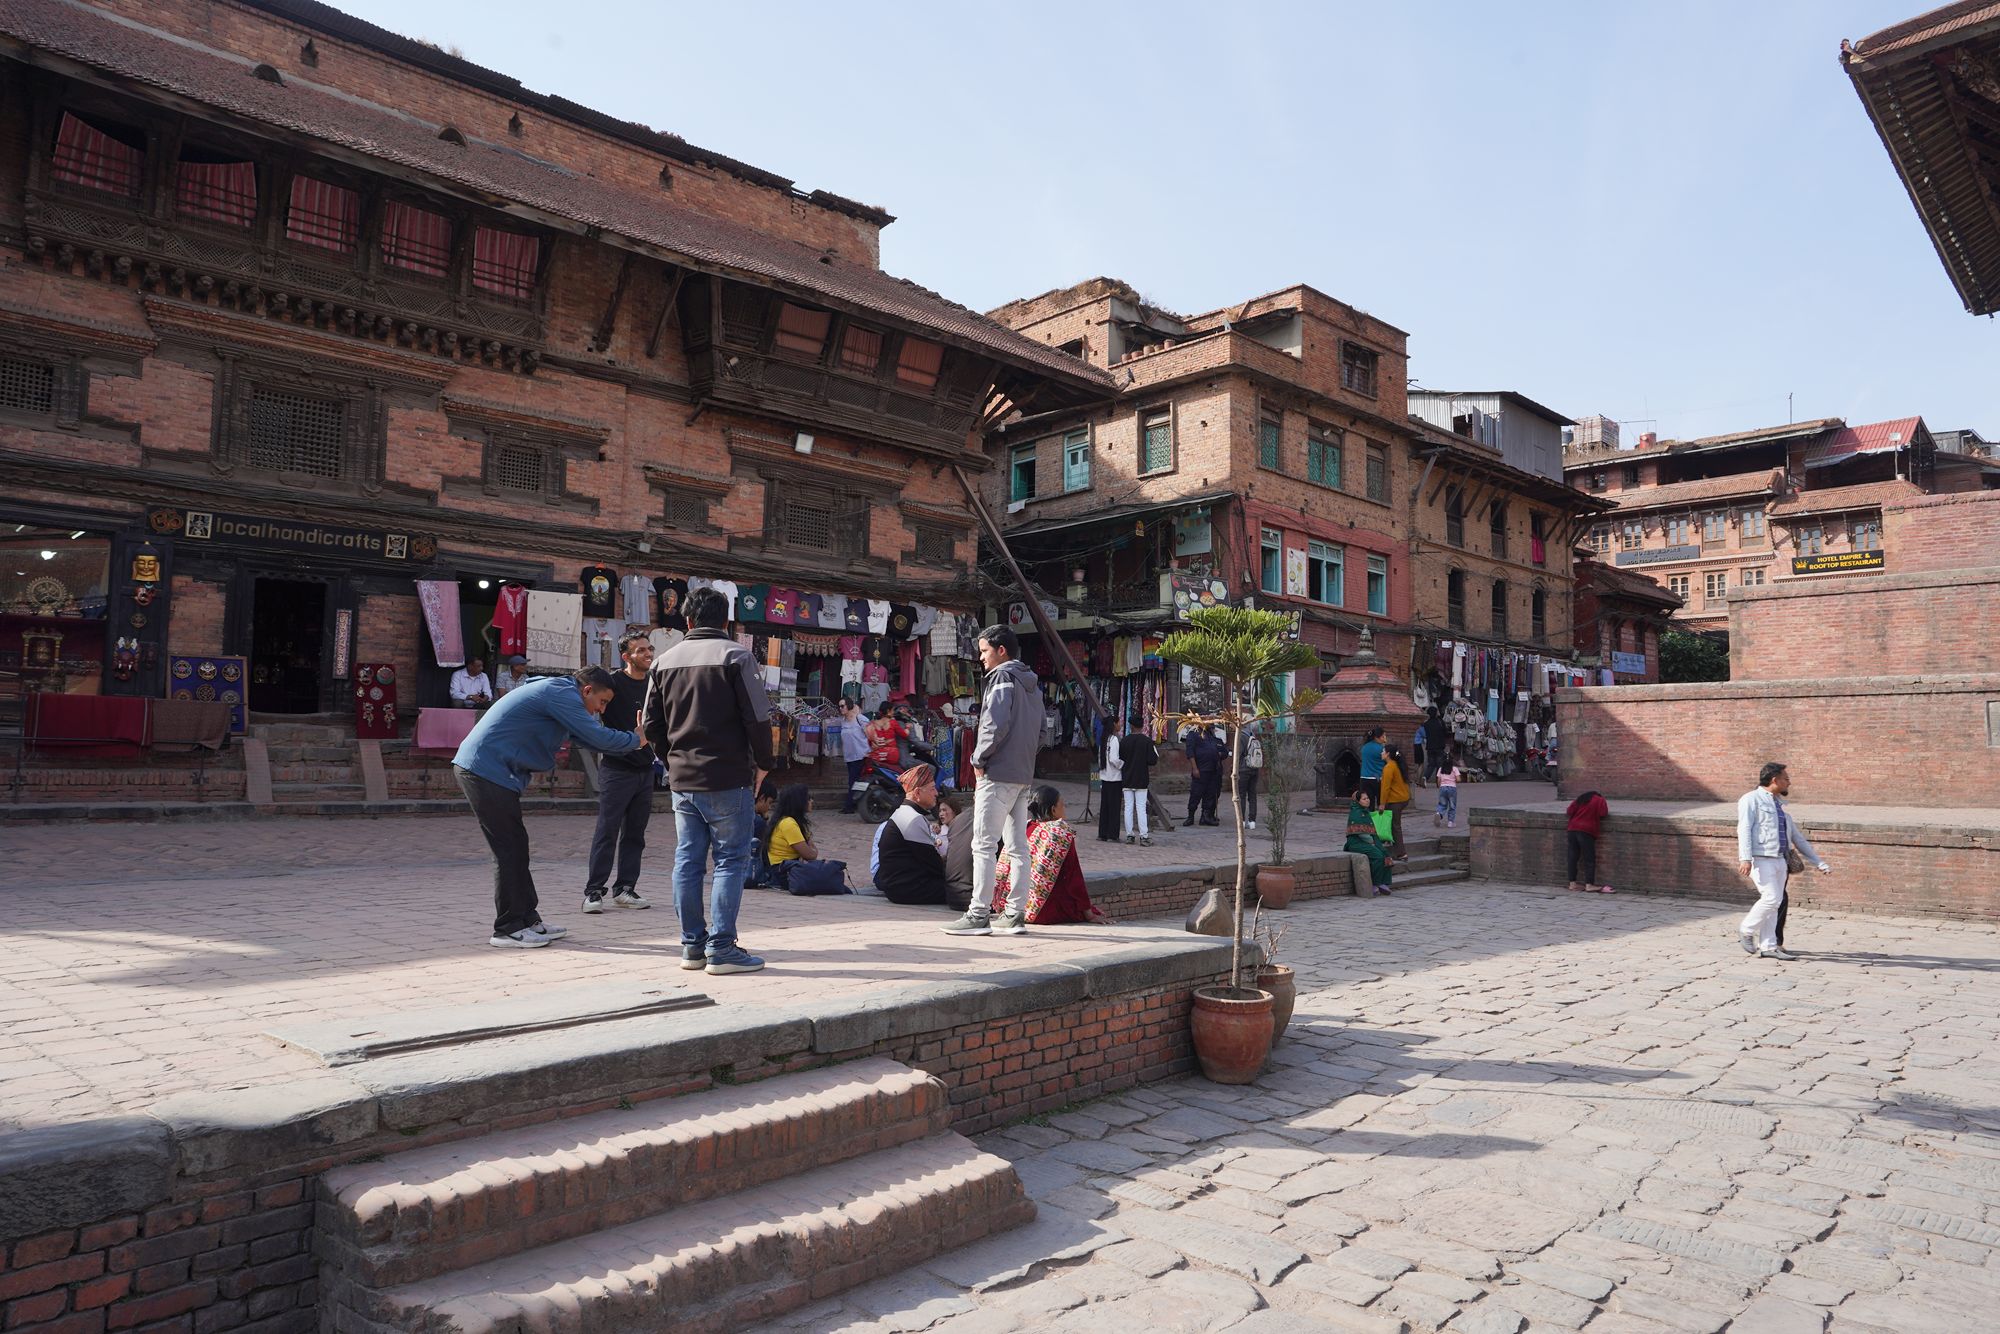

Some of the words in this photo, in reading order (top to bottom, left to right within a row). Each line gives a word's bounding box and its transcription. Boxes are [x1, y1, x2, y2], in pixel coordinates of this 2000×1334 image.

[1817, 555, 1839, 563] HOTEL
[1839, 553, 1863, 561] EMPIRE
[1809, 562, 1840, 570] ROOFTOP
[1840, 558, 1882, 567] RESTAURANT
